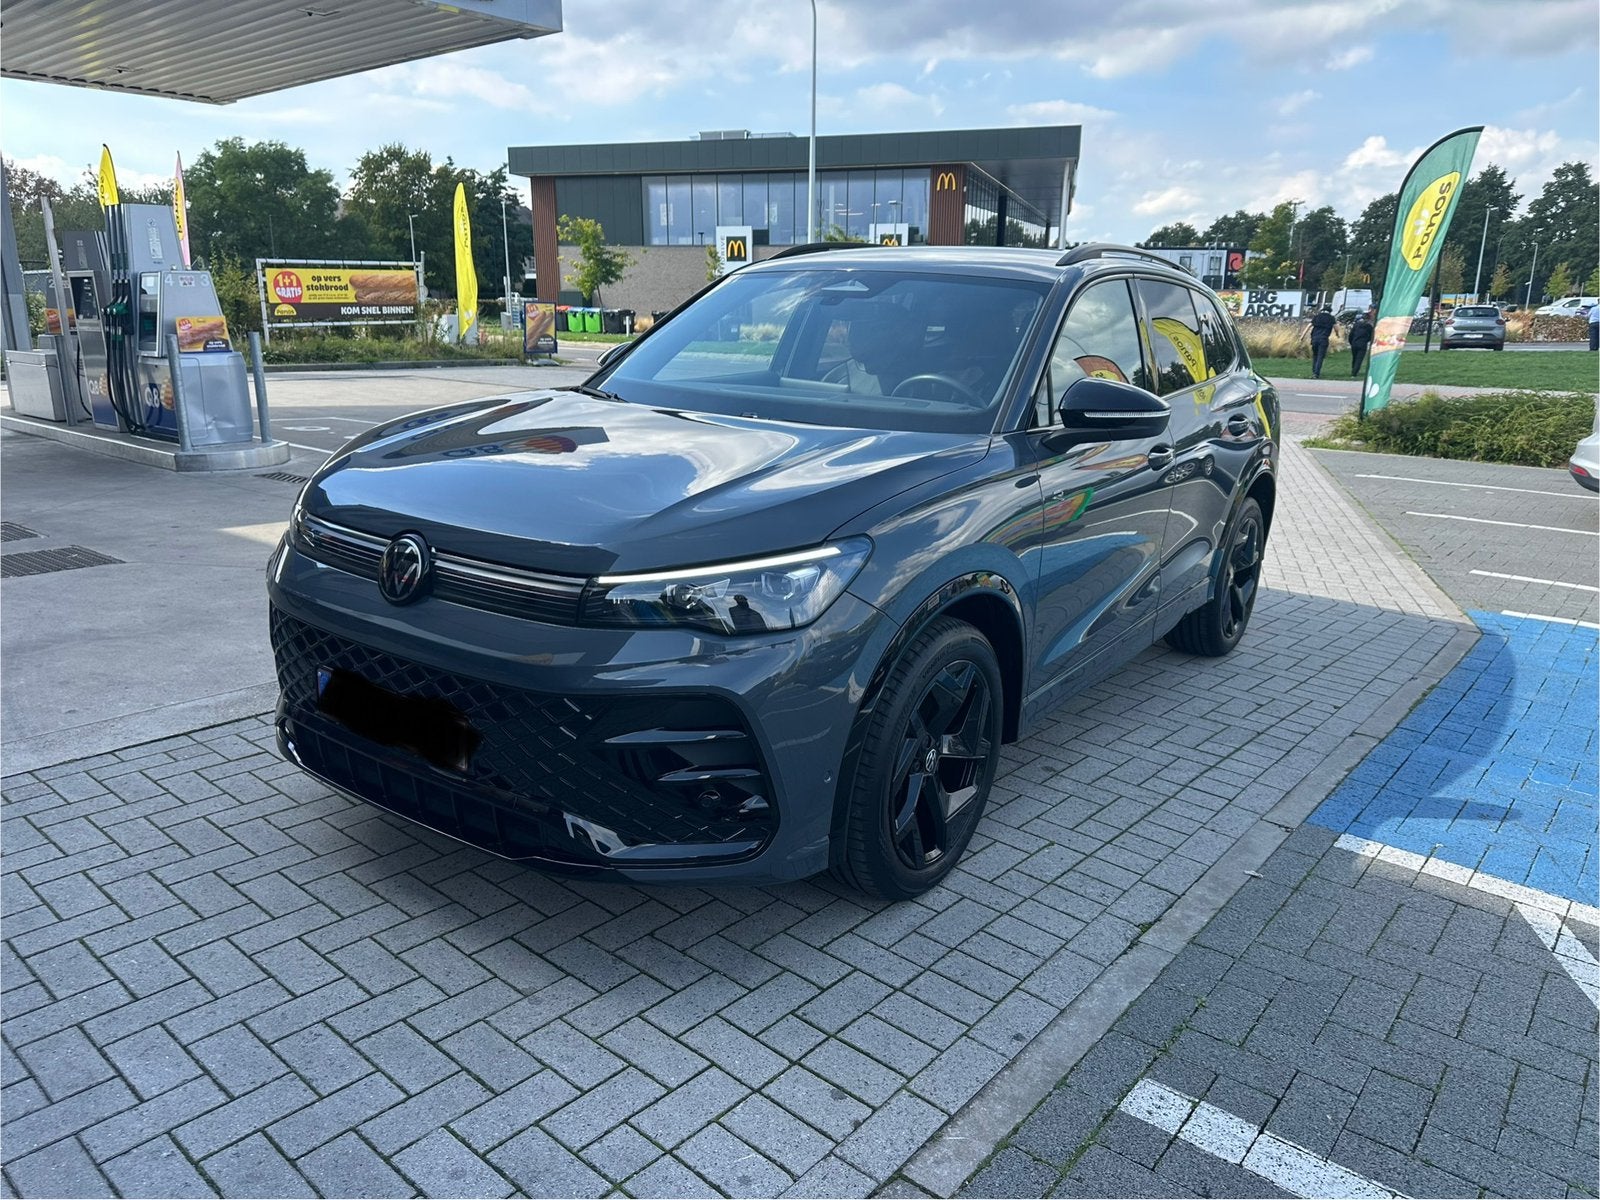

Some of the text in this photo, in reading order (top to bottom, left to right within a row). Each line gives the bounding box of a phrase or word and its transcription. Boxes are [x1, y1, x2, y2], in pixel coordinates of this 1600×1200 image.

[200, 274, 210, 286] 3
[277, 274, 298, 286] 1+1
[312, 275, 322, 283] op
[275, 287, 302, 299] GRATIS
[1248, 290, 1278, 304] BIG
[341, 306, 414, 315] KOM SNEL BINNEN!
[1244, 304, 1295, 317] ARCH
[89, 380, 99, 395] Q8
[145, 386, 160, 408] Q8
